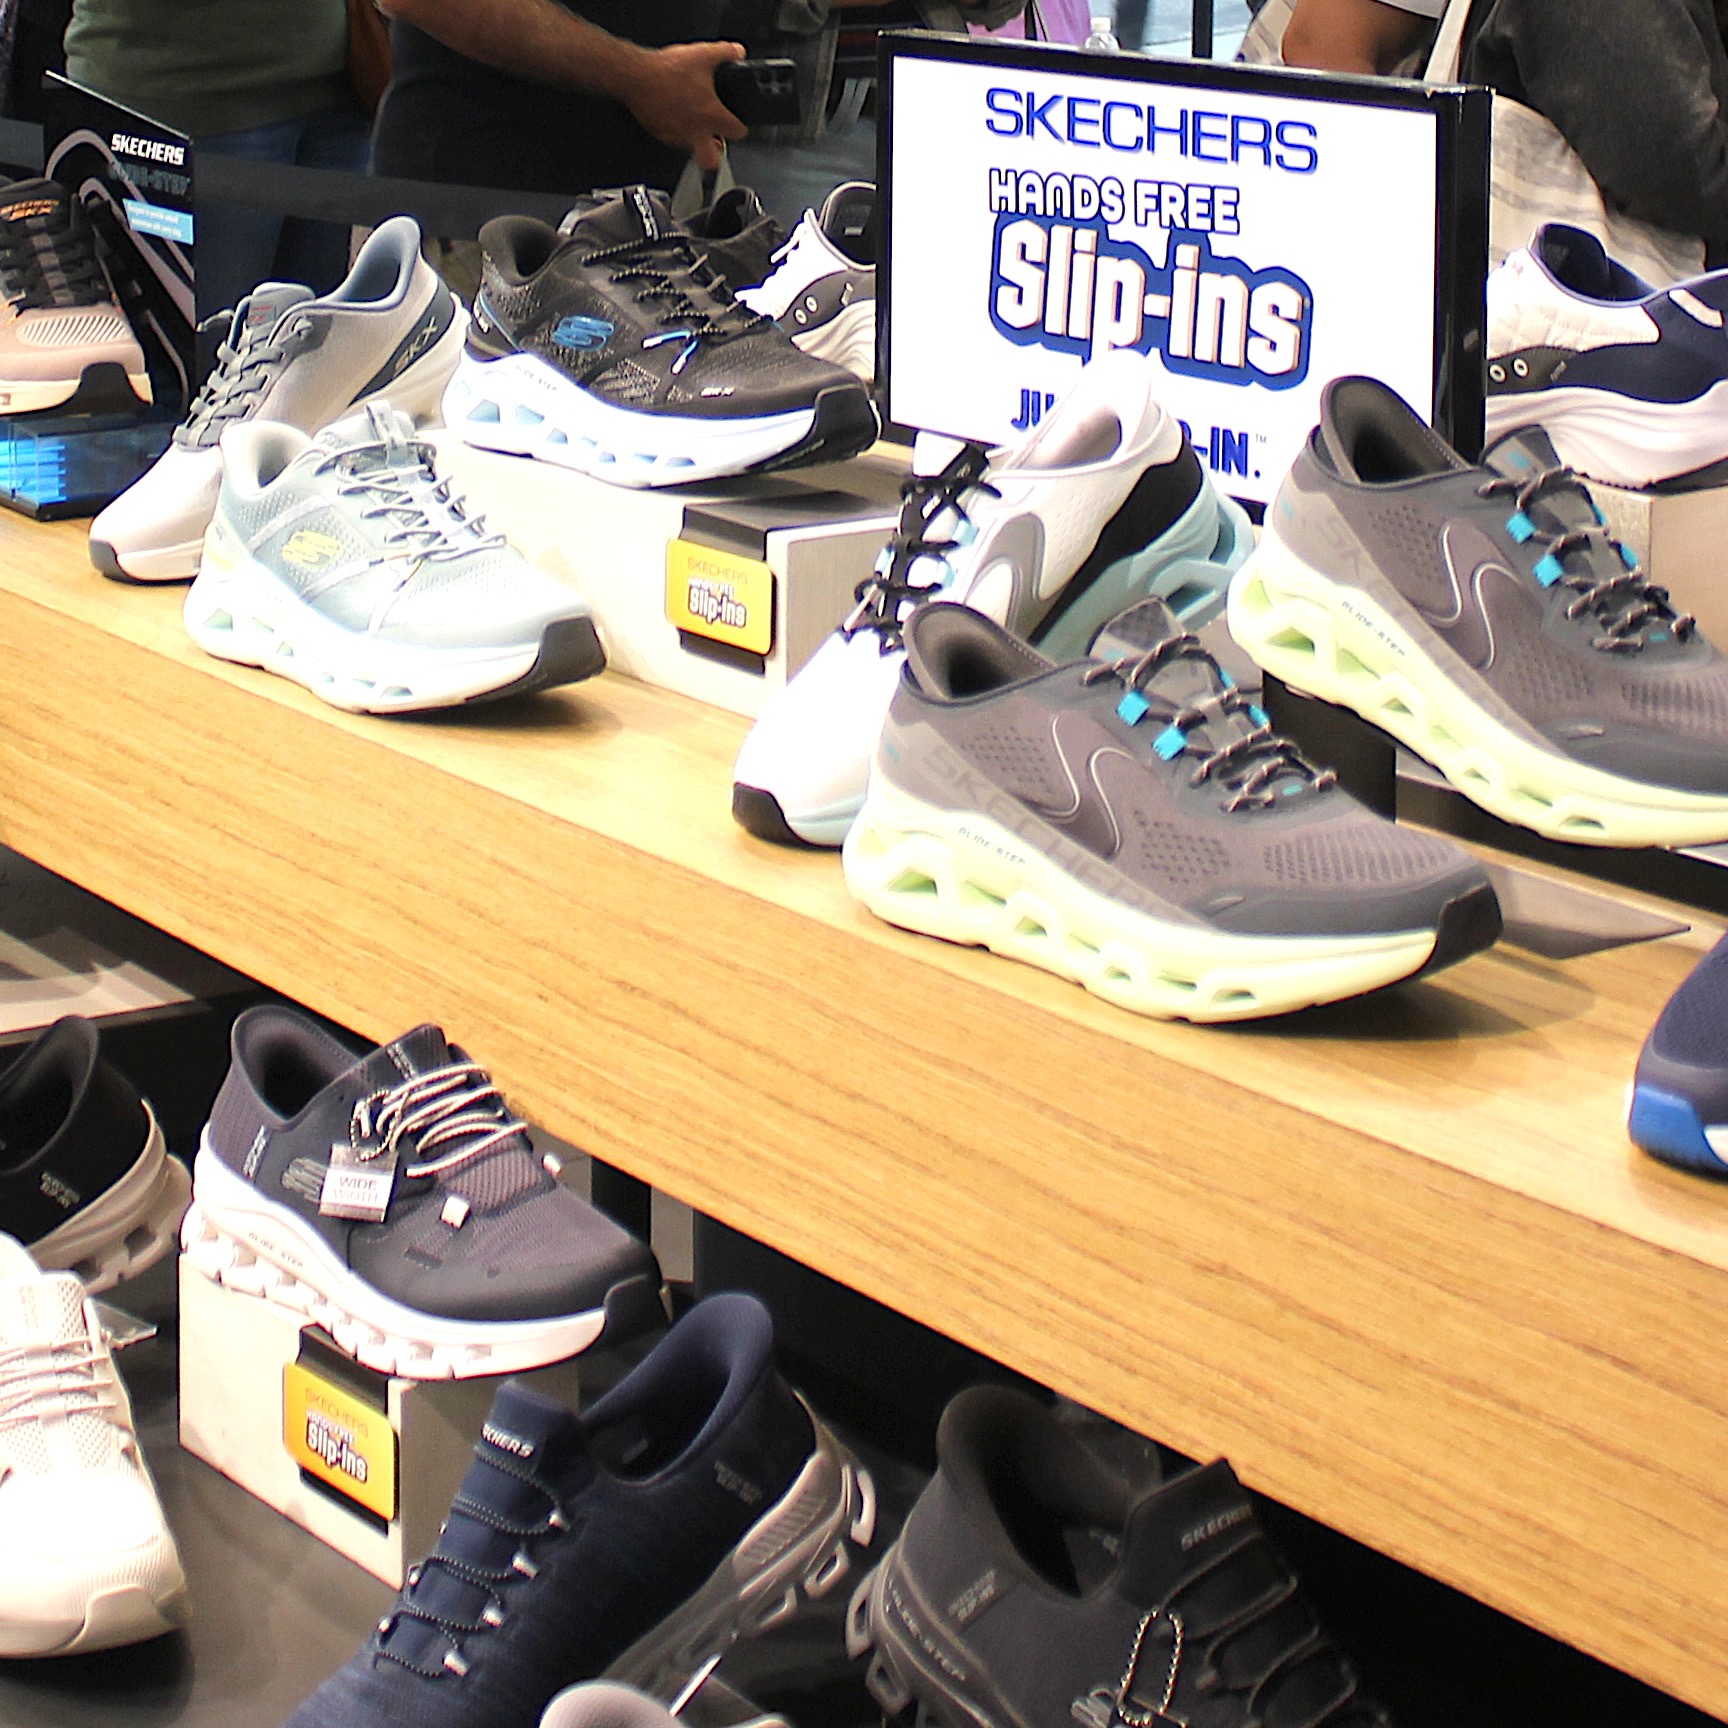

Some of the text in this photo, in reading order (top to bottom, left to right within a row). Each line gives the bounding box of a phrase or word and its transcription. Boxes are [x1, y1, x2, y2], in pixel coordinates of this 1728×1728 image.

[110, 133, 185, 166] SKECHERS
[985, 86, 1319, 175] SKECHERS
[989, 168, 1240, 235] HANDS FREE
[991, 214, 1310, 384] Slip-ins
[687, 586, 747, 628] Slip-ins
[339, 1175, 379, 1191] WIDE
[306, 1417, 368, 1483] Slip-ins
